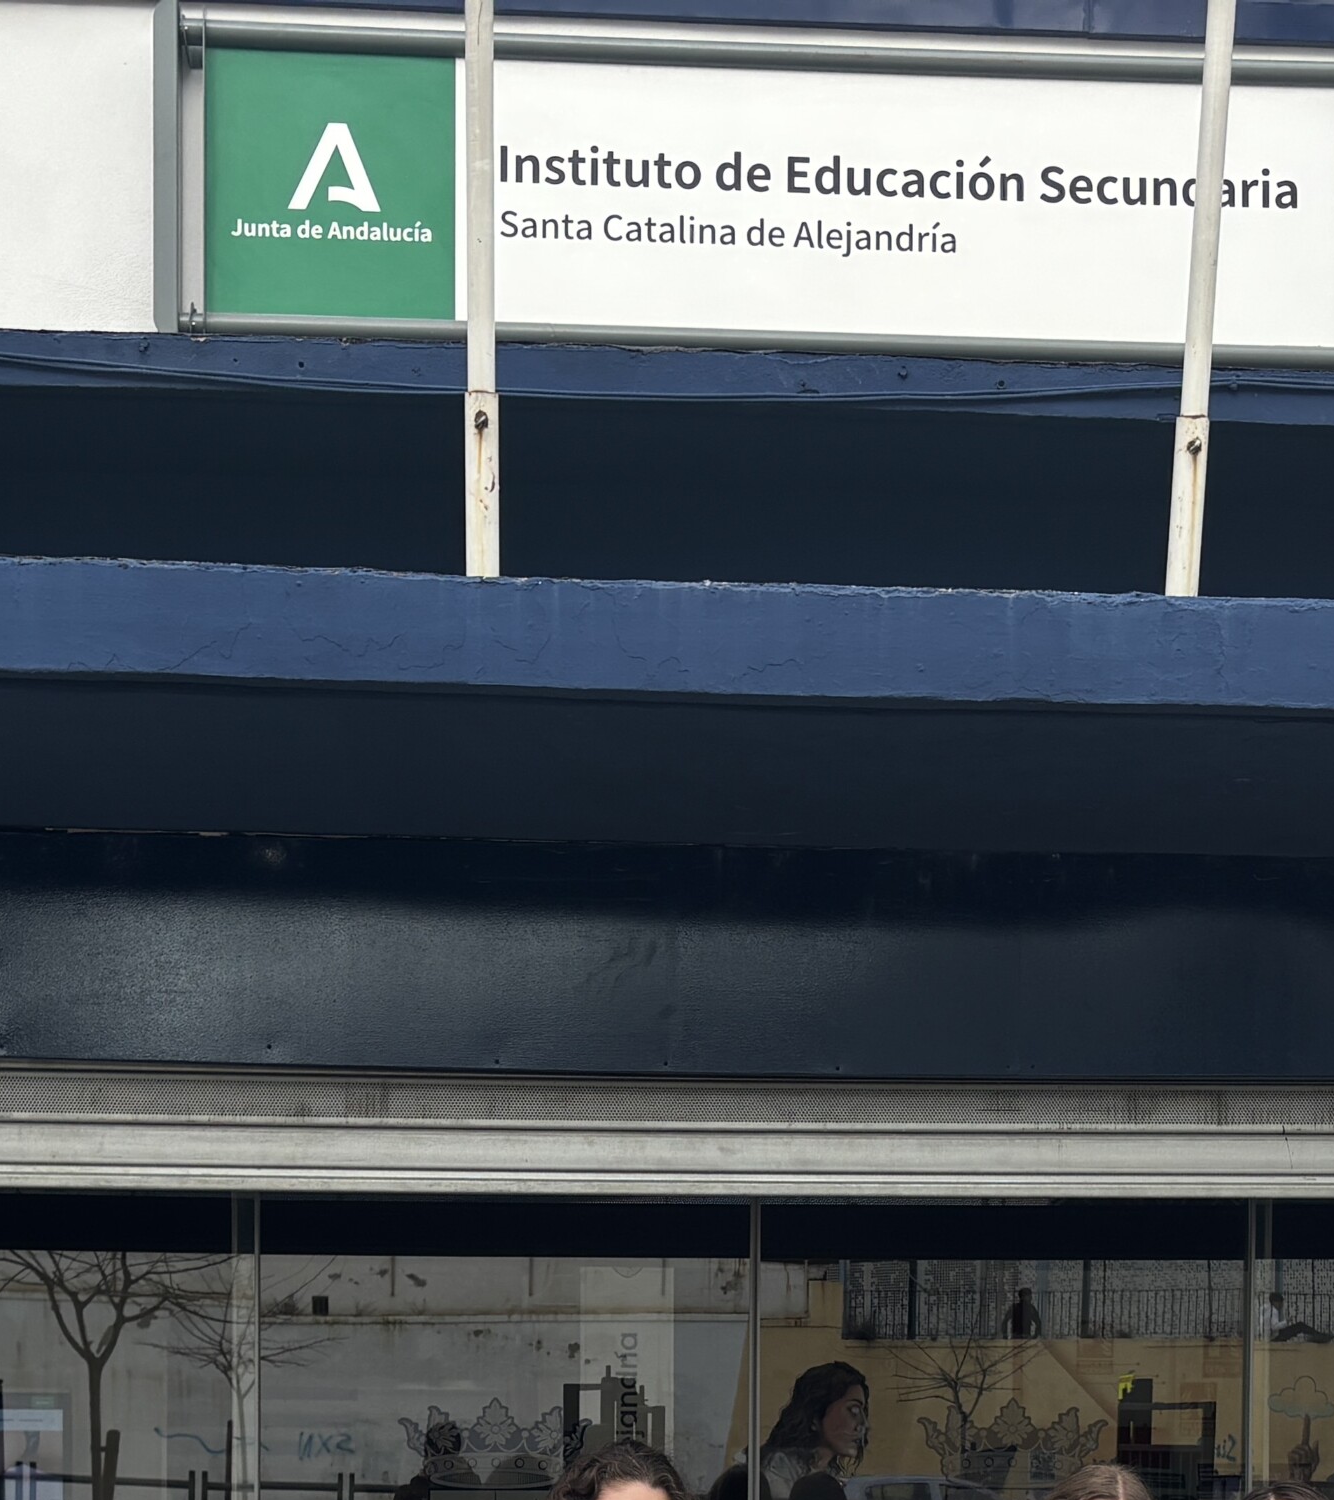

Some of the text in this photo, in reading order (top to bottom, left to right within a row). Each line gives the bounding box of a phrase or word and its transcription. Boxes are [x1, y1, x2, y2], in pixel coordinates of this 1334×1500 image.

[499, 145, 702, 190] Instituto
[715, 151, 771, 193] de
[787, 155, 1025, 203] Educación
[231, 218, 433, 243] Junta de Andalucía
[499, 210, 958, 258] Santa Catalina de Alejandría
